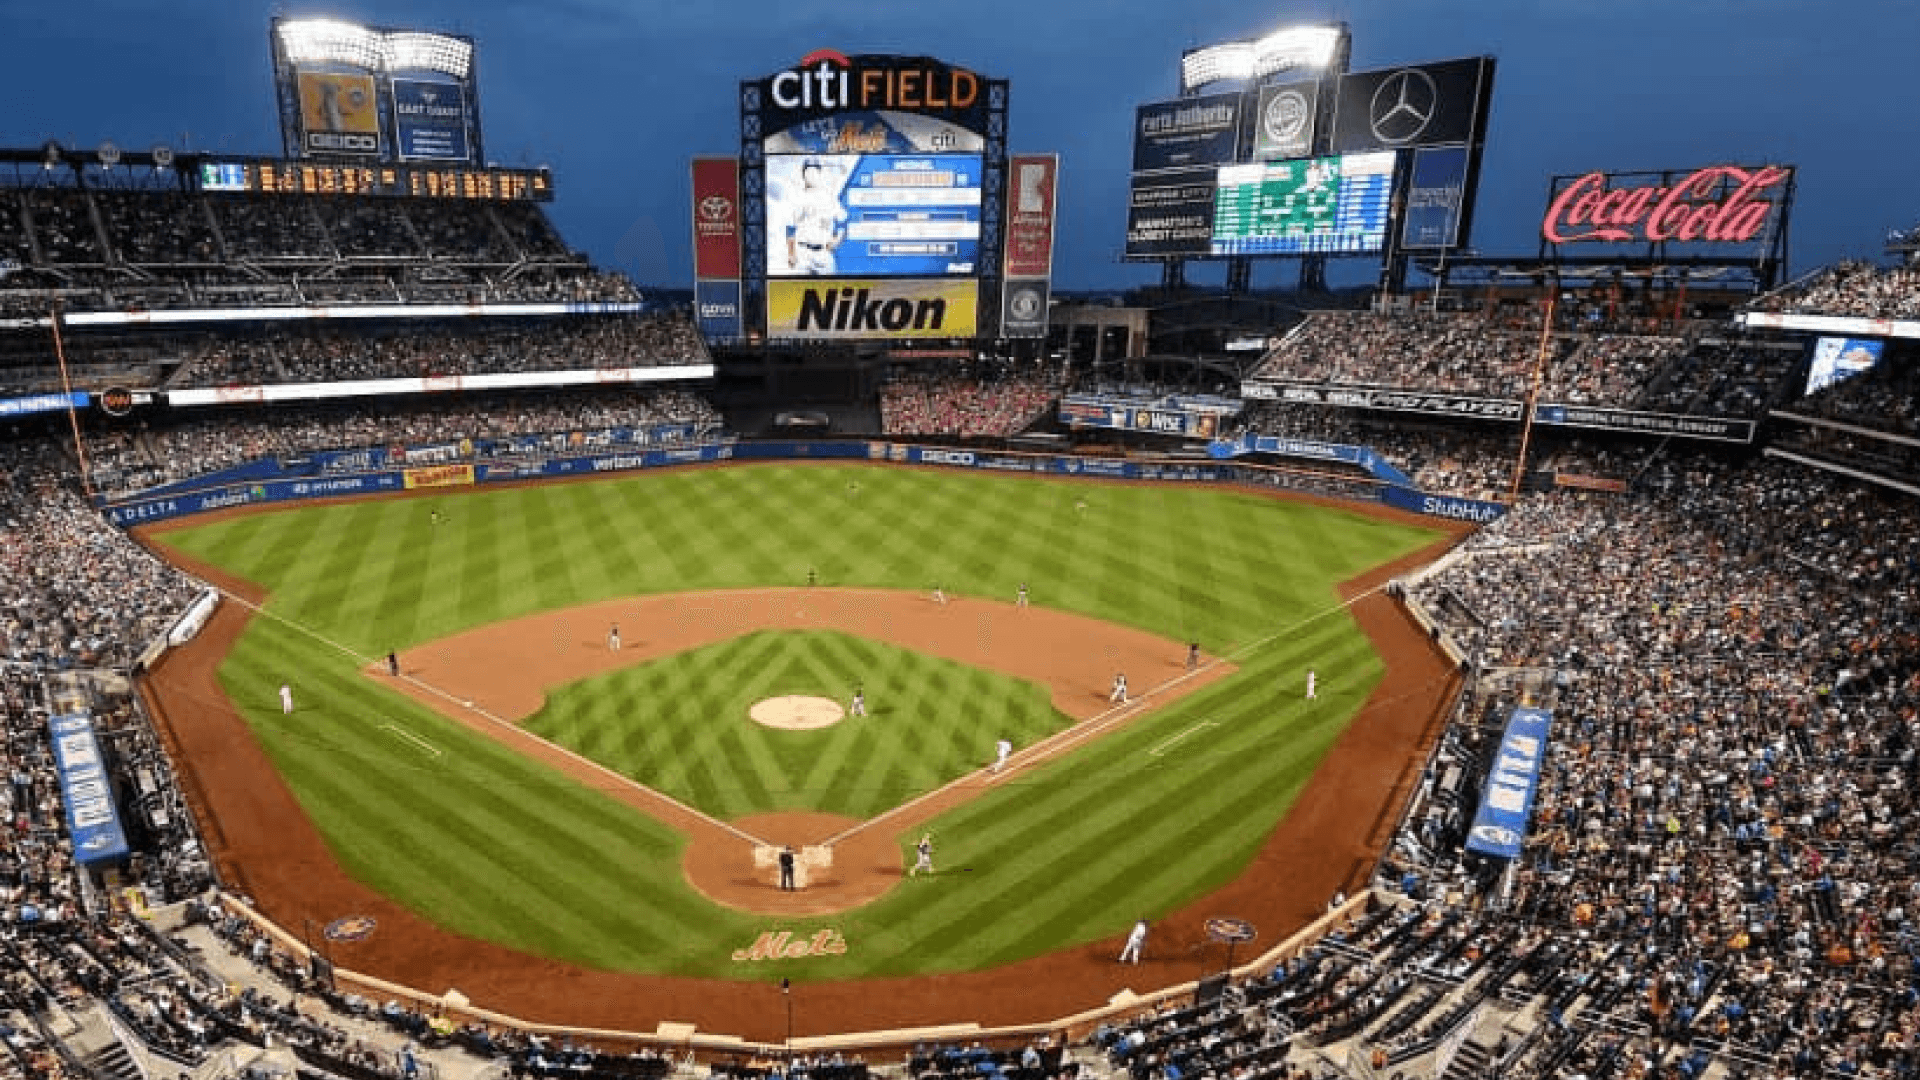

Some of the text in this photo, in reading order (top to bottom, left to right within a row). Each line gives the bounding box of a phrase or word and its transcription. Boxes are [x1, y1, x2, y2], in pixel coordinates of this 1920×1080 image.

[860, 70, 979, 108] FIELD
[310, 134, 376, 148] GEICO
[1543, 164, 1792, 243] Coca-Cola
[797, 287, 947, 331] Nikon
[921, 450, 974, 466] GEICO
[125, 501, 176, 520] DELTA
[732, 928, 847, 960] Mets
